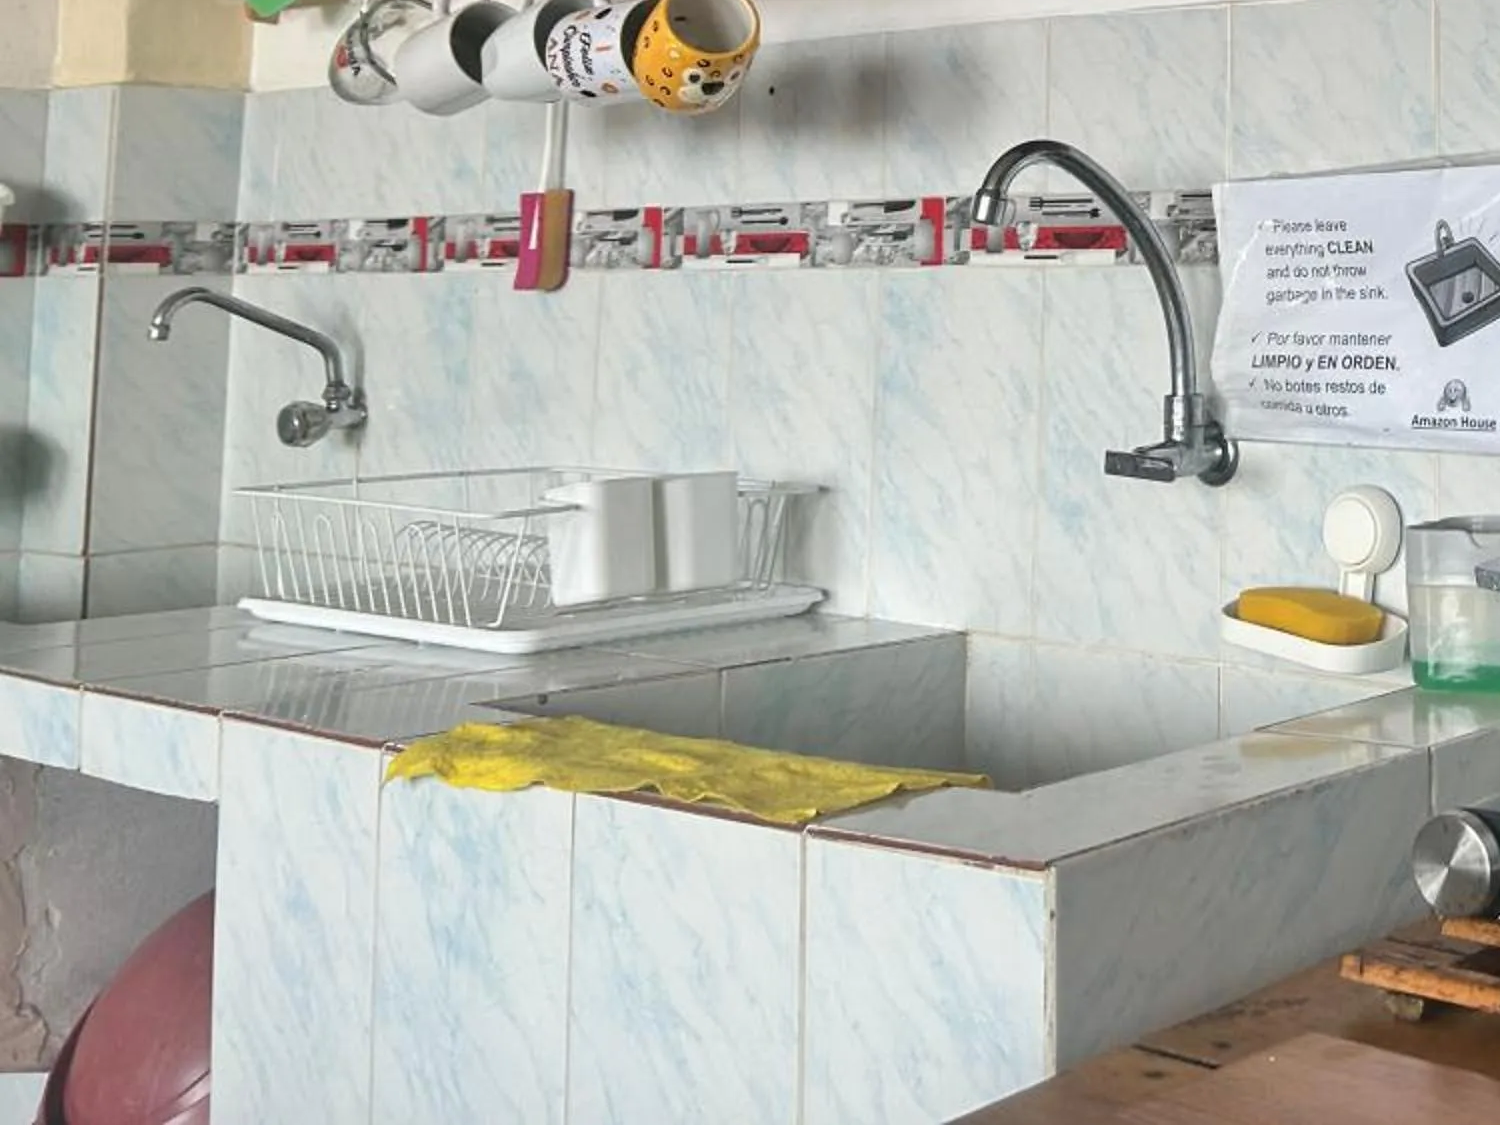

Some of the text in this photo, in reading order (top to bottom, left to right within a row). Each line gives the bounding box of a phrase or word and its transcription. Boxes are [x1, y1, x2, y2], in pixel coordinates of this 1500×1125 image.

[1272, 219, 1347, 233] Please leave
[1265, 240, 1373, 258] everything CLEAN
[1267, 264, 1367, 279] and do not throw
[1265, 285, 1389, 305] garbage in the sink.
[1267, 331, 1392, 346] Por favor mantener
[1251, 354, 1400, 373] LIMPIO y EN ORDEN.
[1263, 378, 1386, 395] No botes restos de
[1412, 414, 1497, 430] Amazon House
